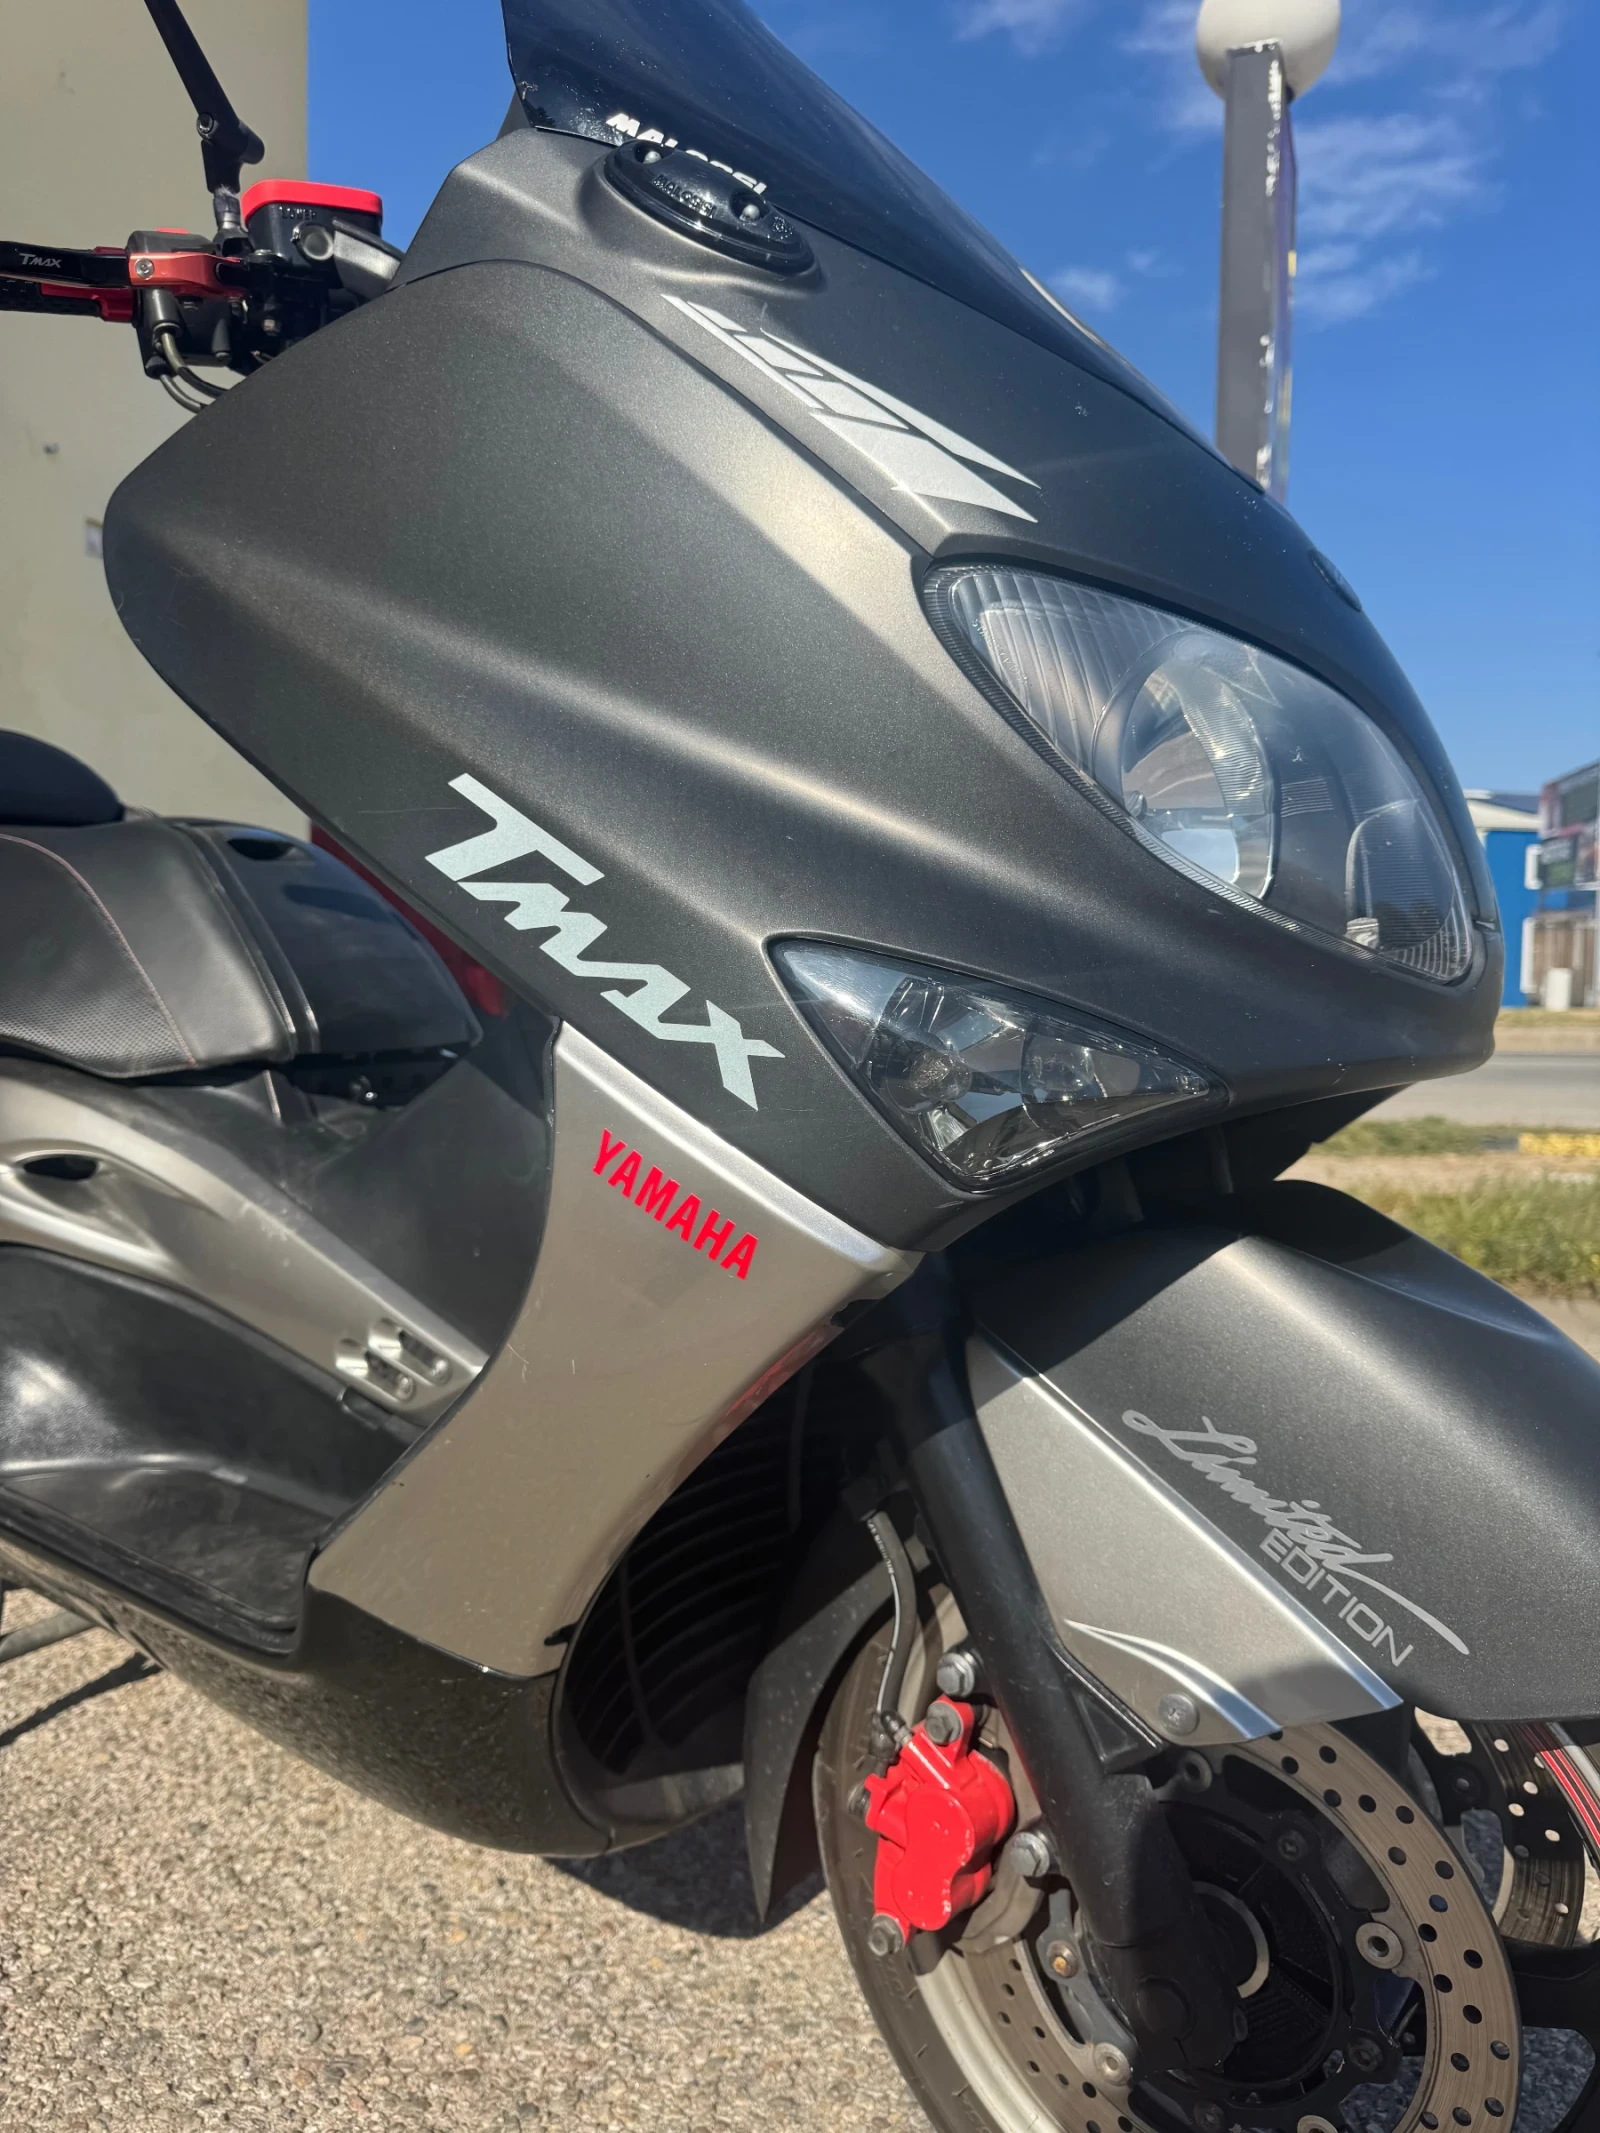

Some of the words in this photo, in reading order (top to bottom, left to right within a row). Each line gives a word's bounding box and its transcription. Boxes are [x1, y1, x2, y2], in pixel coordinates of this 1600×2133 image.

[606, 113, 767, 195] MASI
[591, 1128, 760, 1281] YAMAHA
[1122, 1409, 1470, 1655] Limited
[1259, 1527, 1414, 1666] EDITION
